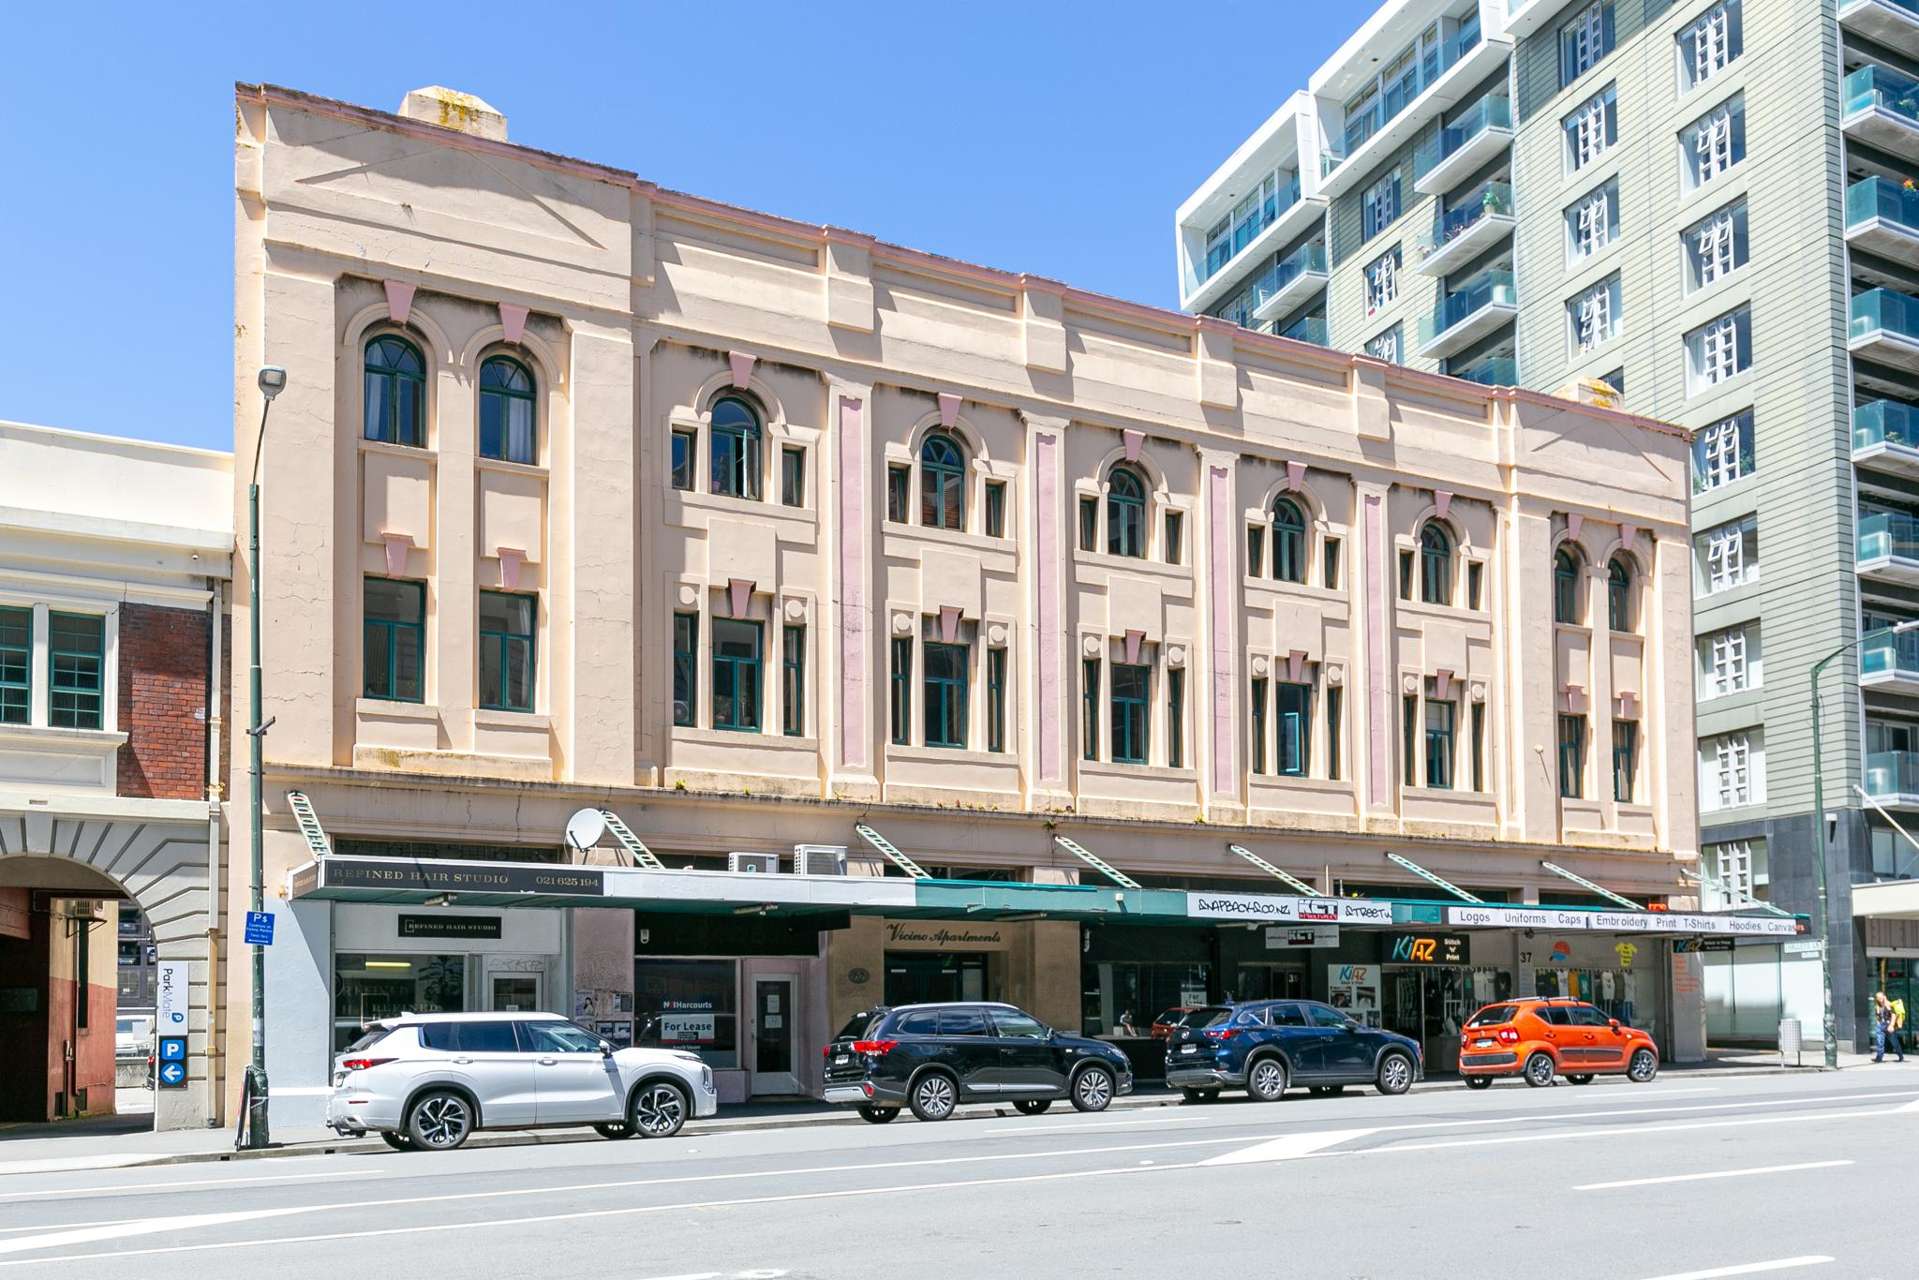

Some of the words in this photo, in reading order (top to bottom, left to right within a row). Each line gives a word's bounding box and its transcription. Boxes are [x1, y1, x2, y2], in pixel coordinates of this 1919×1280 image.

[333, 868, 404, 880] REFINED
[410, 871, 449, 881] HAIR
[453, 872, 509, 884] STUDIO
[1460, 911, 1491, 924] Logos
[1505, 913, 1547, 925] Uniforms
[1558, 914, 1581, 926] Caps
[1596, 914, 1648, 928] Embroidery
[1656, 917, 1676, 929] Print
[1683, 918, 1716, 930] T-Shirts
[1729, 920, 1762, 931] Hoodies
[886, 922, 929, 941] Vicino
[929, 928, 1001, 946] Apartments
[1519, 952, 1532, 963] 37
[163, 968, 174, 1018] ParkMate
[676, 1000, 712, 1009] Harcourts
[664, 1022, 682, 1031] For
[683, 1021, 712, 1031] Lease
[166, 1045, 179, 1056] P
